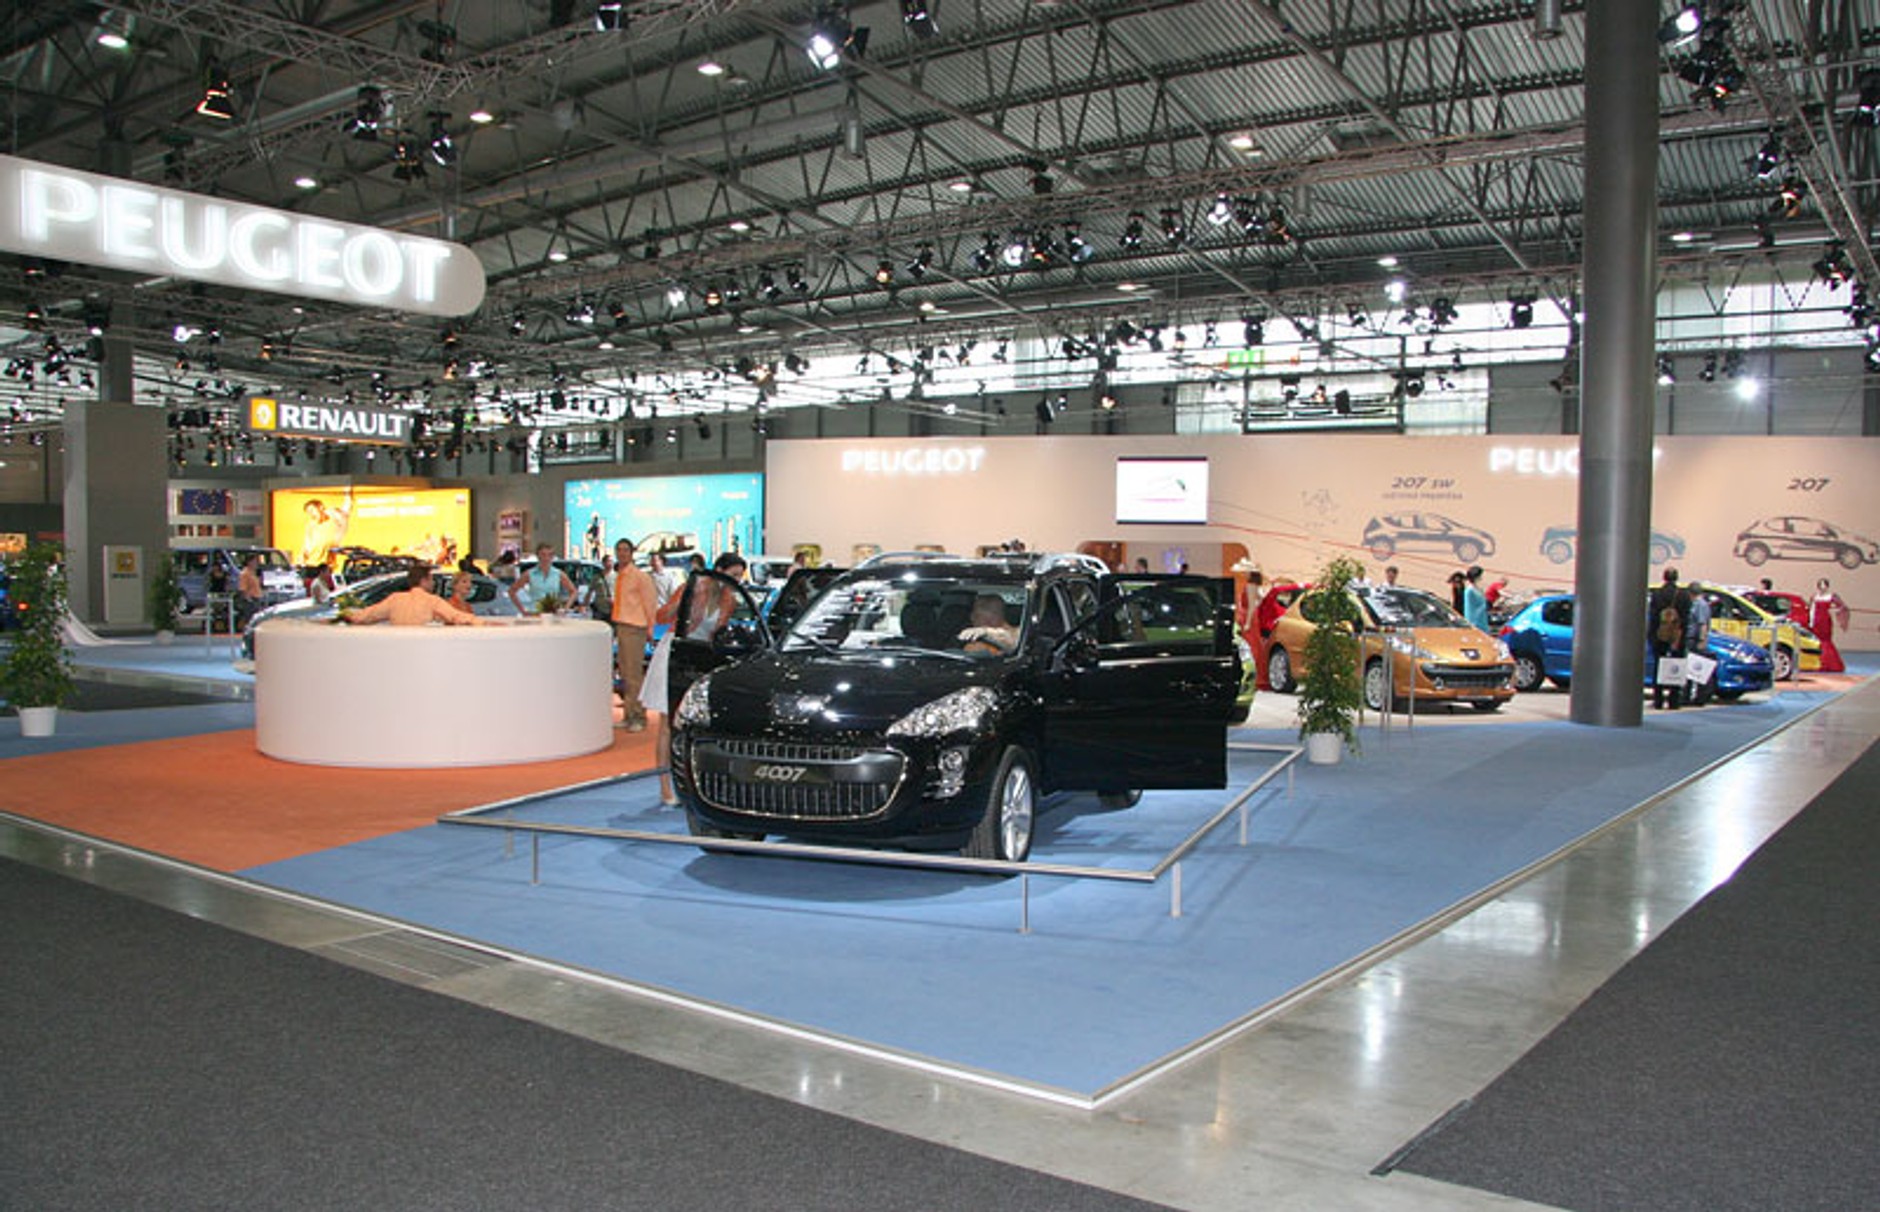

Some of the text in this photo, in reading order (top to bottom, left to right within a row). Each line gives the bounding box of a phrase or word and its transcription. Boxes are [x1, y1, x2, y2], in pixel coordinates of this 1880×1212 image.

[19, 167, 452, 301] PEUGEOT
[279, 403, 407, 437] RENAULT
[841, 447, 985, 474] PEUGEOT
[1489, 446, 1662, 474] PEUG
[1391, 476, 1427, 489] 207
[1787, 478, 1830, 492] 207
[754, 764, 807, 781] 4007
